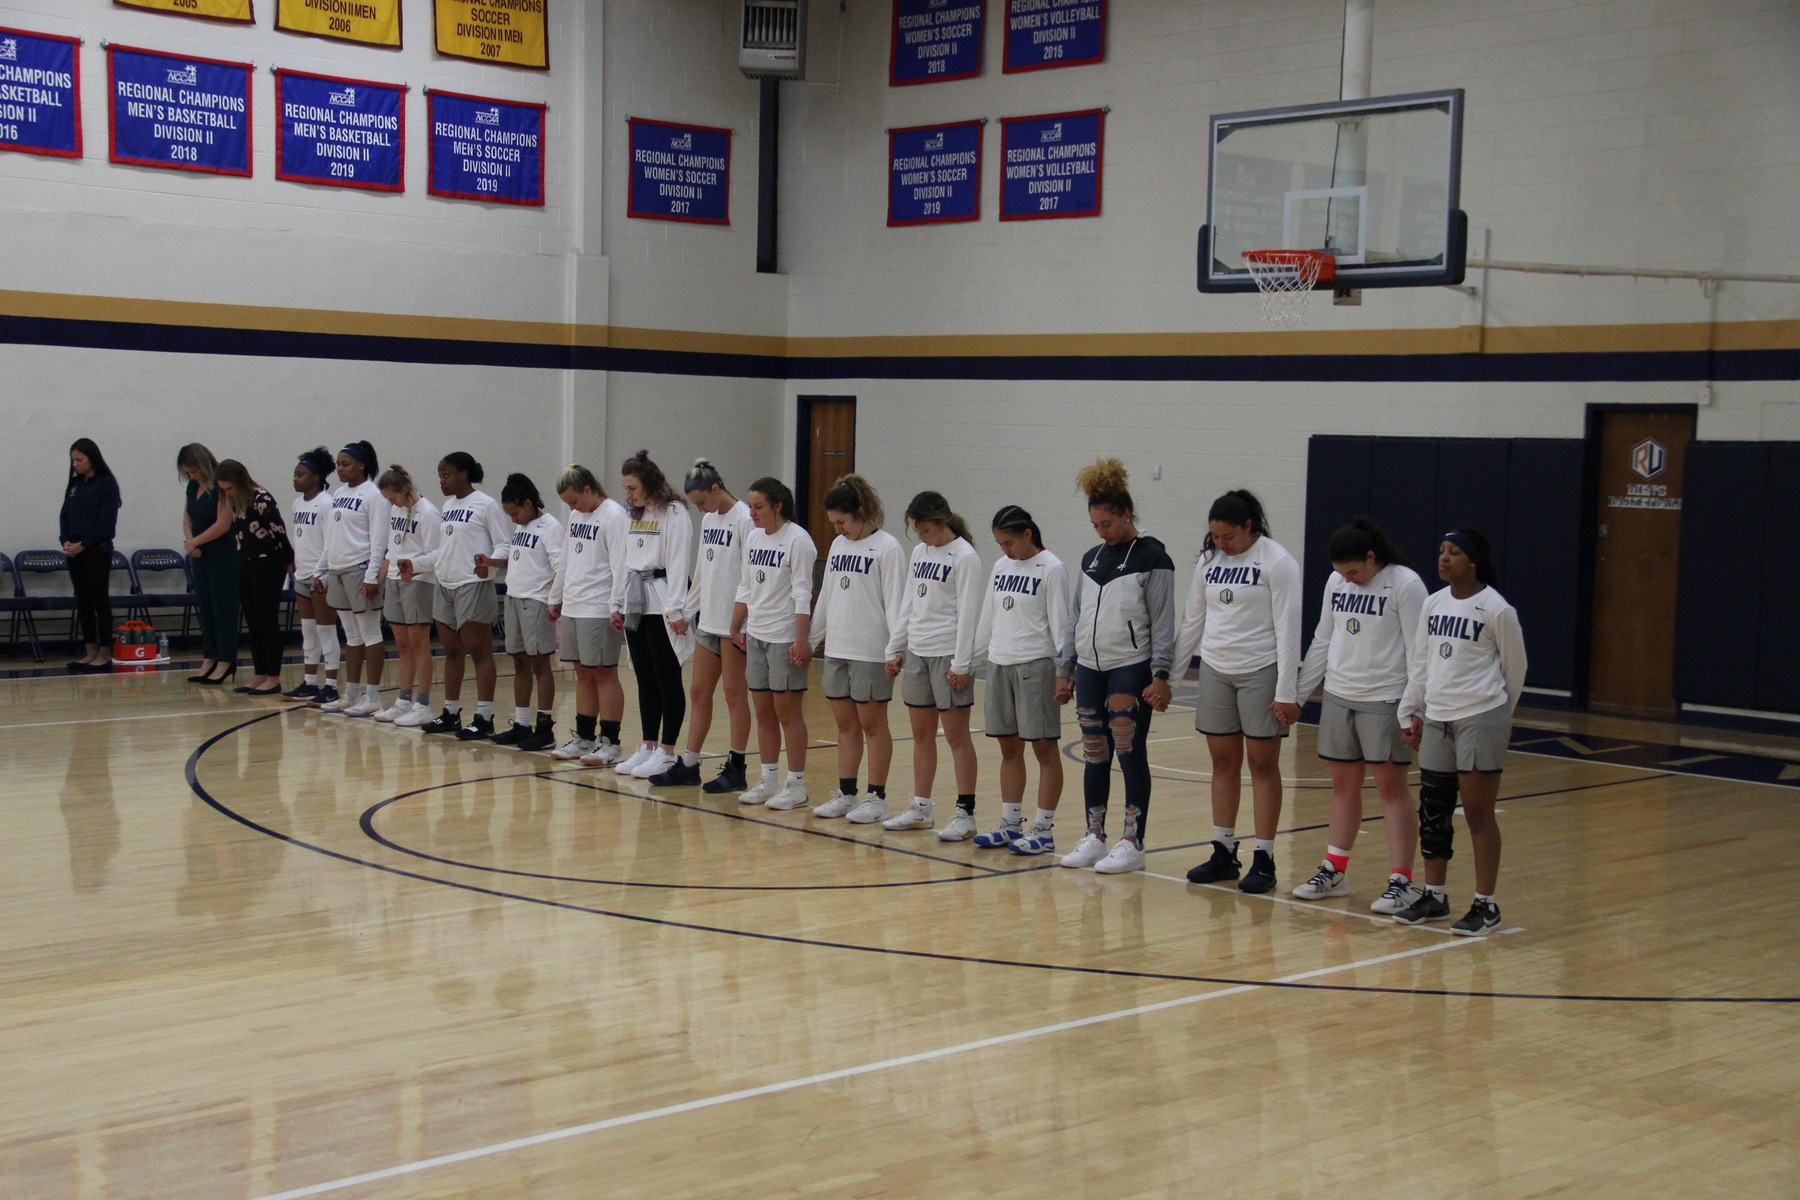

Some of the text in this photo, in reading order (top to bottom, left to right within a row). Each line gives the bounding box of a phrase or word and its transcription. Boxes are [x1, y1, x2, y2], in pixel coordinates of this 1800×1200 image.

[354, 4, 376, 20] MEN
[1011, 0, 1050, 13] REGIONAL
[329, 16, 351, 33] 2006
[471, 8, 511, 26] SOCCER
[898, 5, 980, 29] REGIONAL CHAMPIONS
[1010, 6, 1100, 30] WOMEN'S VOLLEYBALL
[457, 23, 497, 40] DIVISION
[504, 29, 523, 44] MEN
[905, 23, 972, 44] WOMEN'S SOCCER
[1033, 26, 1076, 44] DIVISION II
[480, 42, 501, 57] 2007
[918, 42, 958, 59] DIVISION II
[1043, 45, 1063, 60] 2016
[928, 60, 945, 74] 2018
[118, 81, 245, 112] REGIONAL CHAMPIONS
[28, 107, 37, 122] II
[128, 101, 237, 130] MEN'S BASKETBALL
[285, 103, 398, 130] REGIONAL CHAMPIONS
[154, 124, 214, 145] DIVISION II
[294, 122, 391, 146] MEN'S BASKETBALL
[435, 122, 537, 147] REGIONAL CHAMPIONS
[171, 145, 198, 161] 2018
[316, 143, 370, 161] DIVISION II
[453, 141, 520, 162] MEN'S SOCCER
[635, 149, 725, 170] REGIONAL CHAMPIONS
[1007, 142, 1096, 163] REGIONAL CHAMPIONS
[331, 162, 355, 178] 2019
[463, 159, 511, 177] DIVISION II
[893, 151, 976, 171] REGIONAL CHAMPIONS
[1006, 160, 1095, 179] WOMEN'S VOLLEYBALL
[644, 166, 717, 185] WOMEN'S SOCCER
[901, 168, 967, 186] WOMEN'S SOCCER
[476, 178, 498, 192] 2019
[659, 183, 702, 199] DIVISION II
[913, 185, 953, 200] DIVISION II
[1028, 178, 1072, 194] DIVISION II
[671, 200, 690, 213] 2017
[923, 201, 941, 215] 2019
[1039, 196, 1059, 210] 2017
[569, 522, 599, 541] FAMILY
[749, 549, 785, 568] FAMILY
[830, 554, 874, 575] FAMILY
[1204, 565, 1260, 586] FAMILY
[993, 574, 1042, 596] FAMILY
[1331, 592, 1388, 617] FAMILY
[1427, 615, 1485, 642] FAMILY
[135, 647, 145, 658] G
